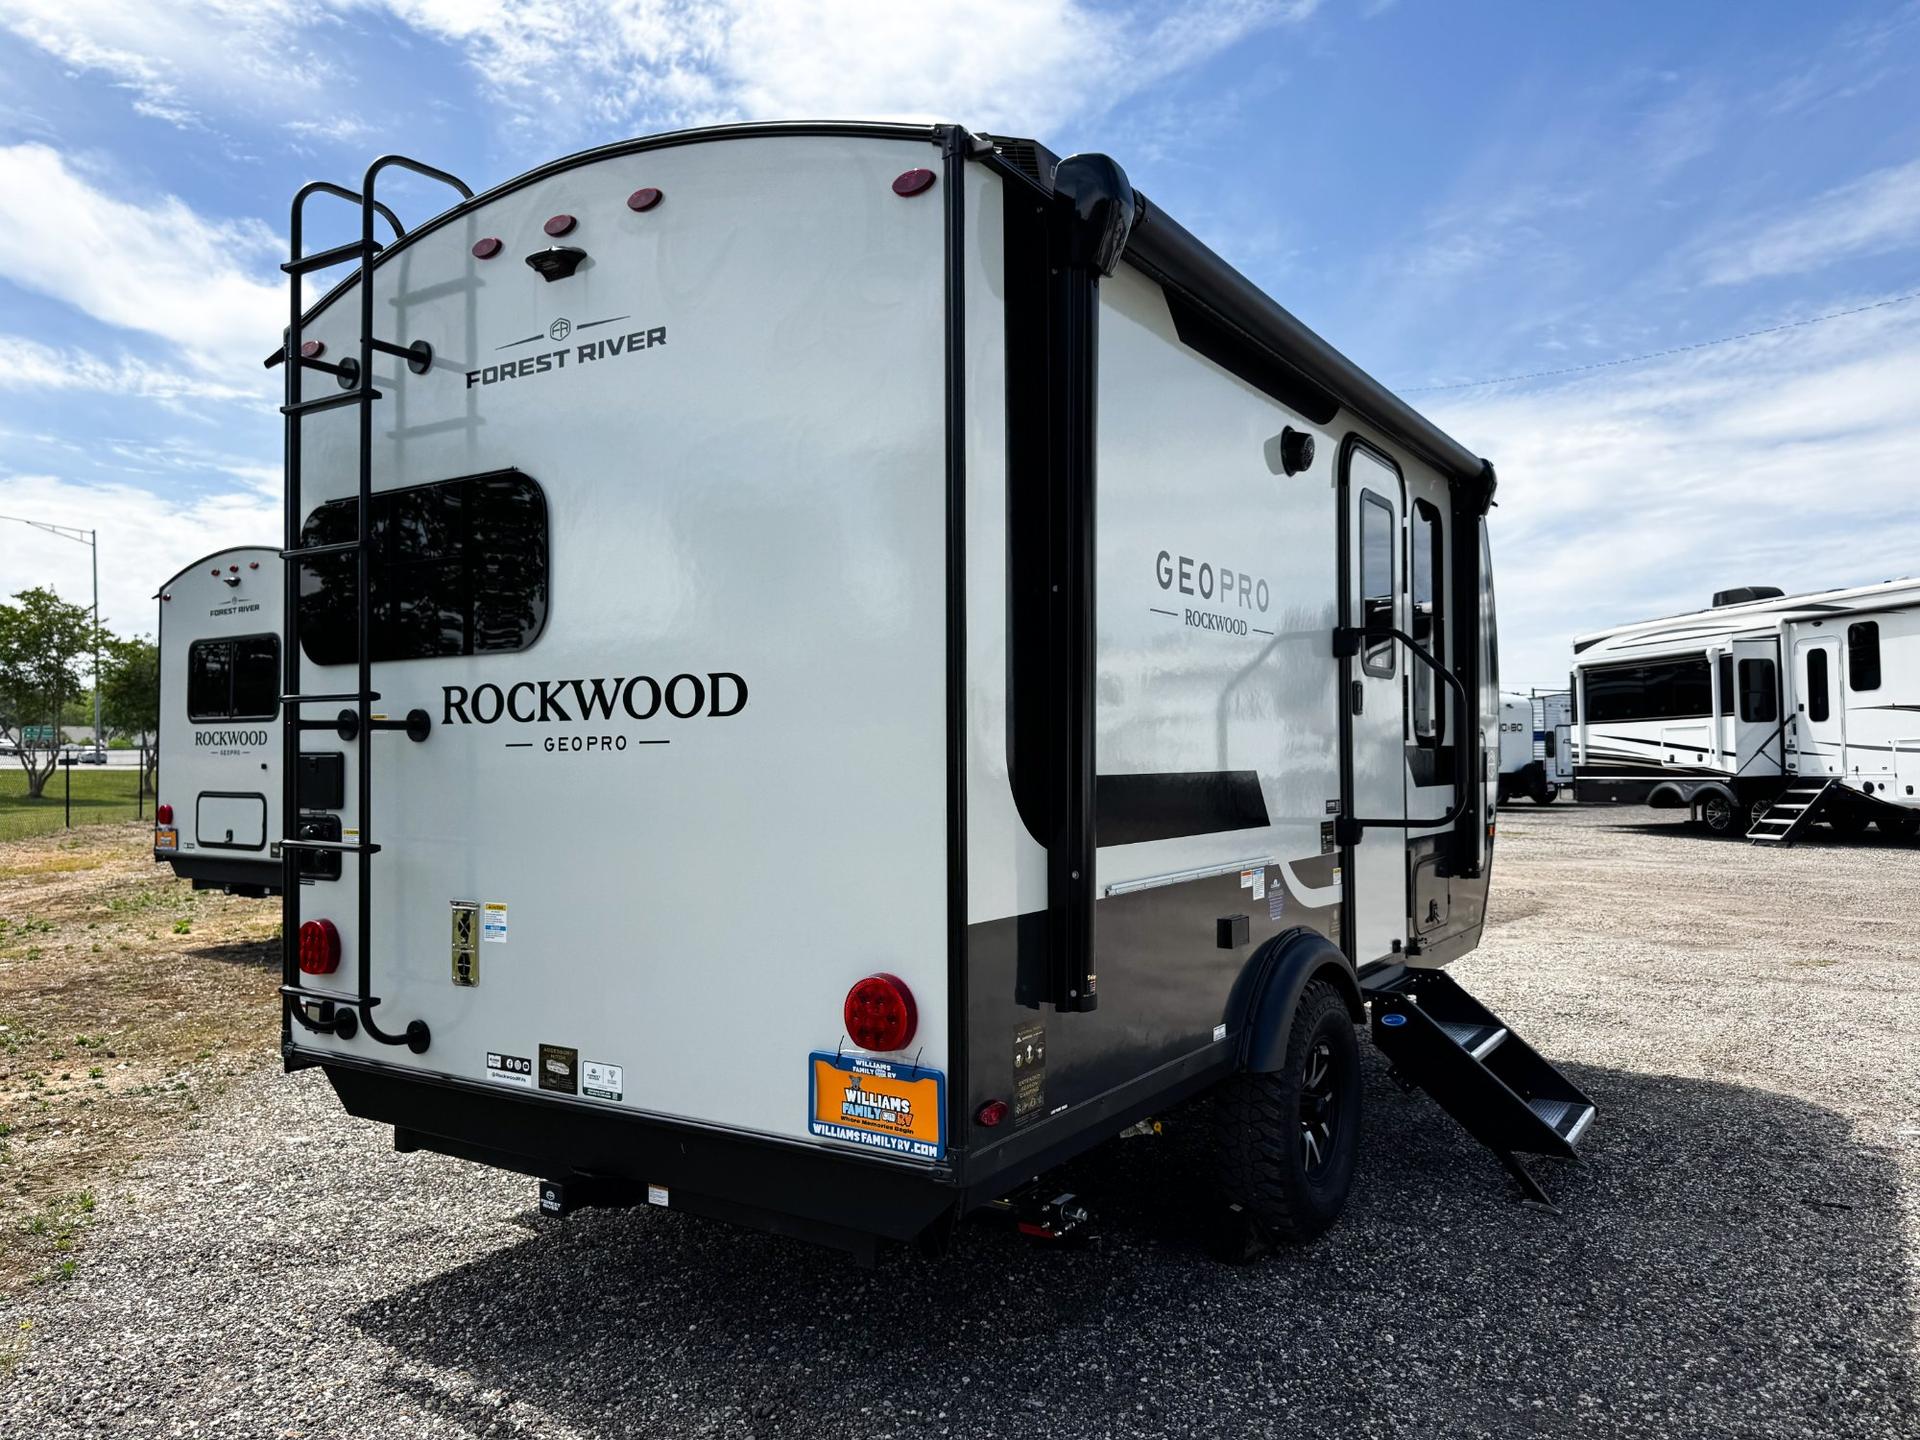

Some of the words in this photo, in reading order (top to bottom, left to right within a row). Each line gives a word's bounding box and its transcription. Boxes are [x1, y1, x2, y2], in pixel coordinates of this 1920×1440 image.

[465, 348, 571, 389] FOREST
[577, 326, 667, 364] RIVER
[1156, 550, 1269, 613] GEOPRO
[209, 606, 237, 617] FOREST
[238, 603, 260, 613] RIVER
[1185, 608, 1247, 636] ROCKWOOD
[441, 672, 748, 725] ROCKWOOD
[195, 730, 268, 746] ROCKWOOD
[544, 735, 627, 752] GEOPRO
[852, 1066, 875, 1075] FAMILY
[887, 1071, 897, 1079] RV
[855, 1059, 891, 1071] WILLIAMS
[845, 1088, 911, 1114] WILLIAMS
[842, 1101, 881, 1120] FAMILY
[896, 1112, 914, 1127] RV
[841, 1116, 861, 1124] Where
[862, 1120, 894, 1131] Memories
[894, 1127, 914, 1135] Begin
